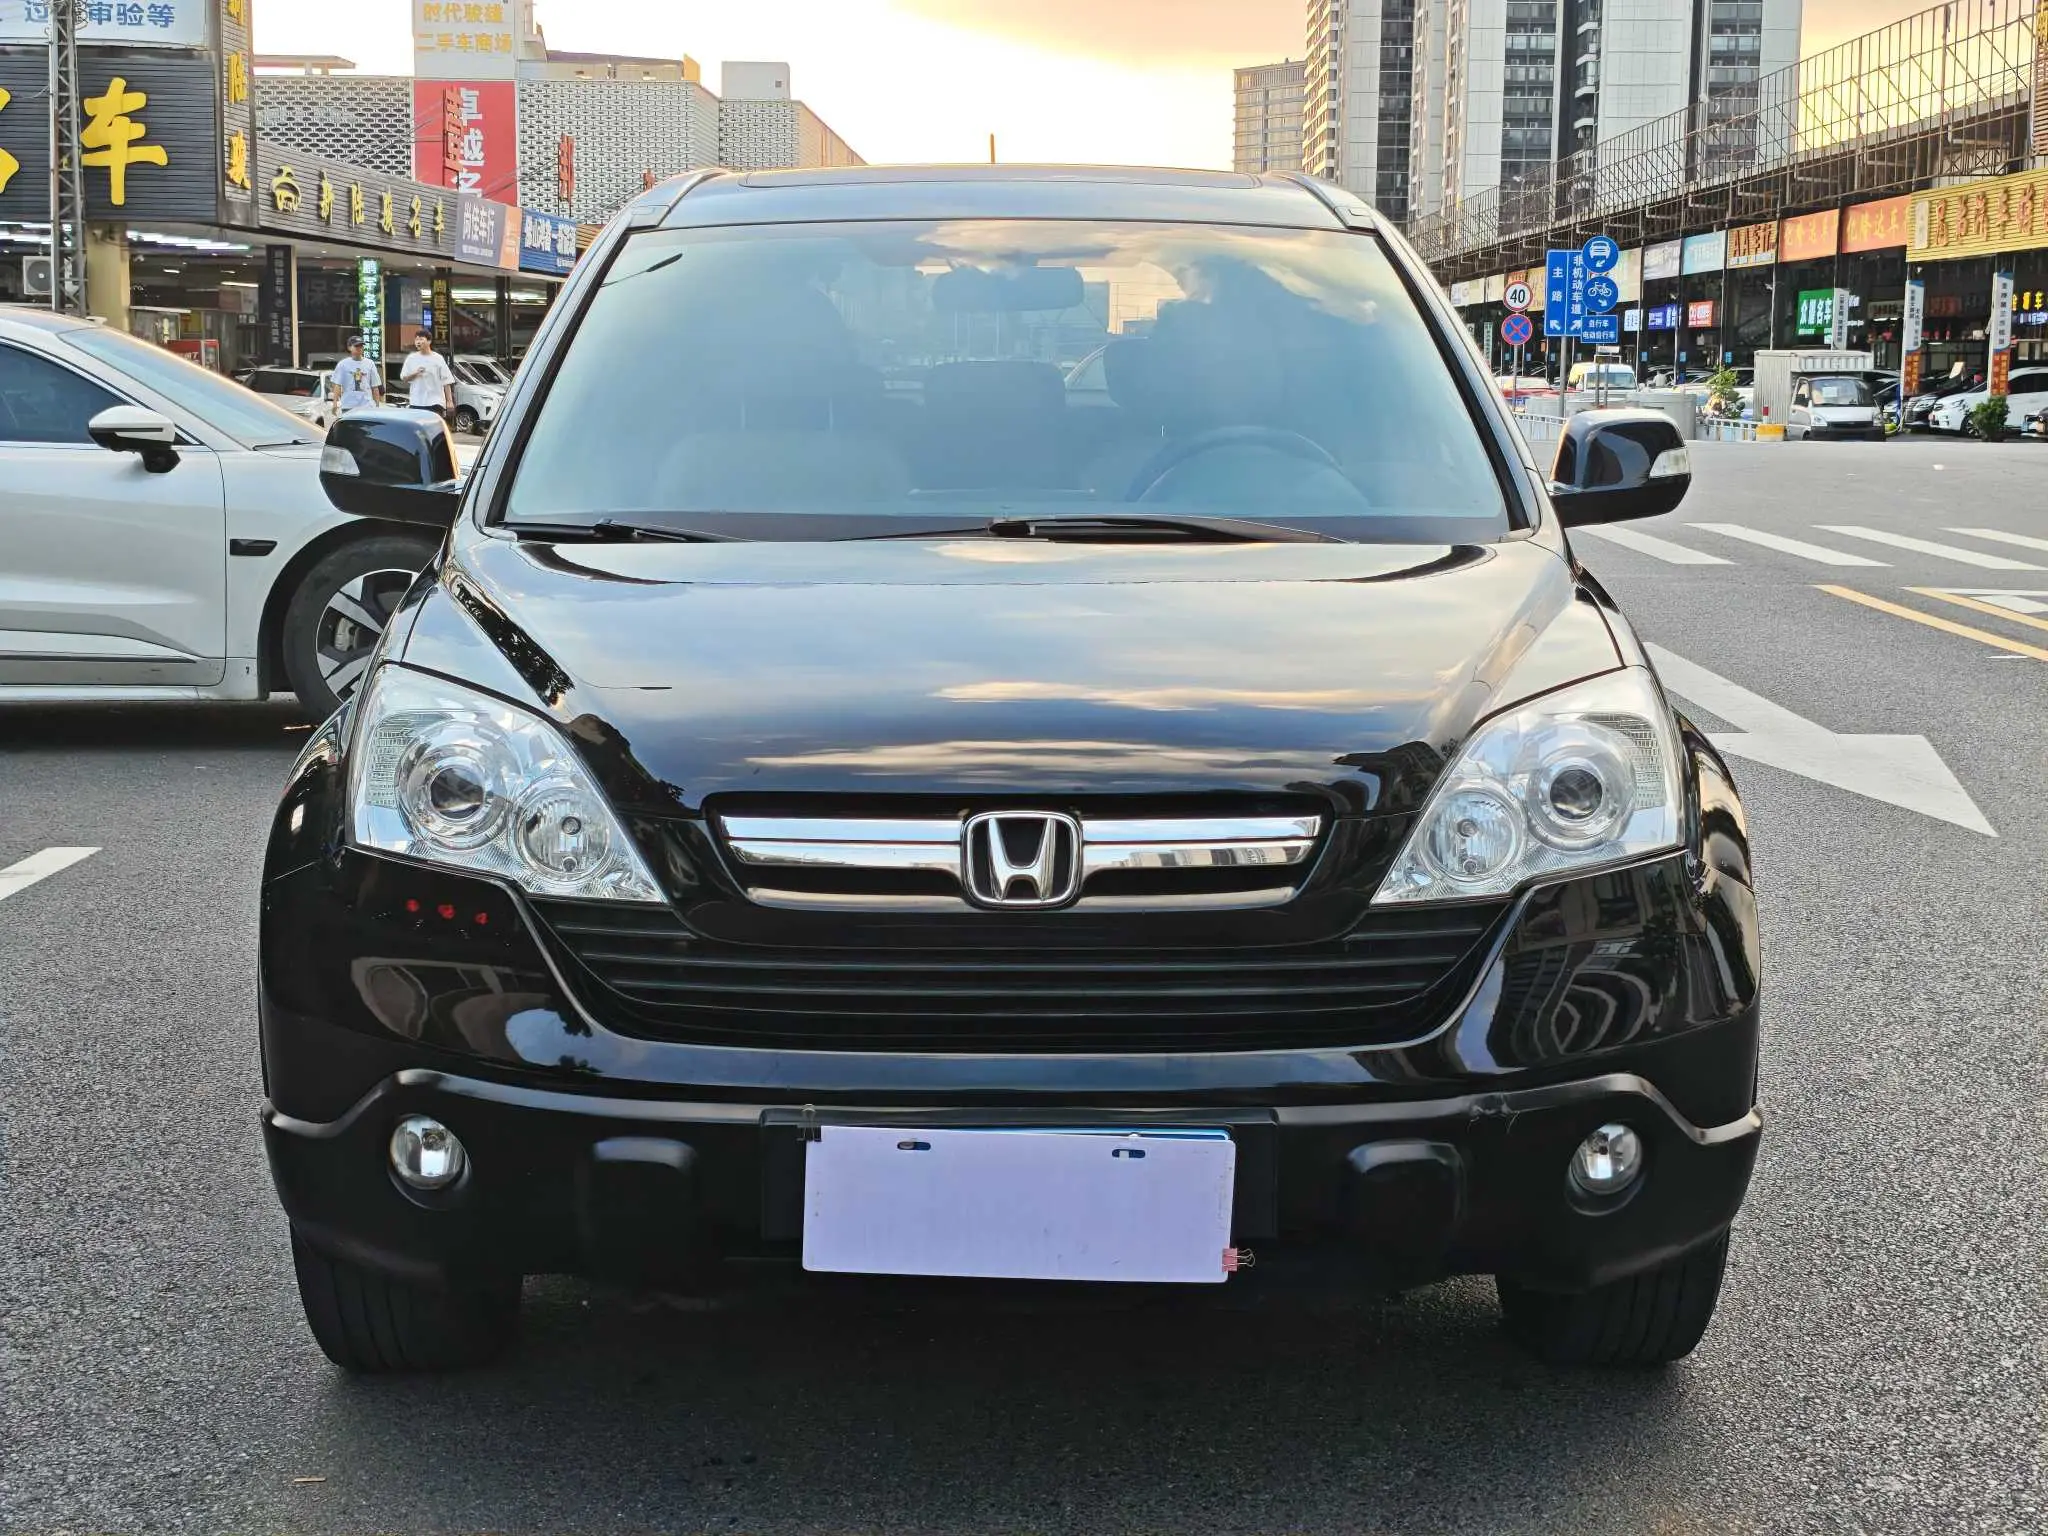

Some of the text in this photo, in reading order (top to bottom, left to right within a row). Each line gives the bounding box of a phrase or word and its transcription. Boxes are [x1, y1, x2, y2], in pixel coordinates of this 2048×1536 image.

[25, 0, 176, 28] 过审验等
[416, 33, 512, 53] 二手车商场
[1552, 267, 1563, 302] 主路
[1571, 255, 1583, 314] 非机动车道
[1510, 289, 1526, 304] 40
[1588, 320, 1609, 328] 自行车
[1582, 331, 1615, 339] 电动自行车
